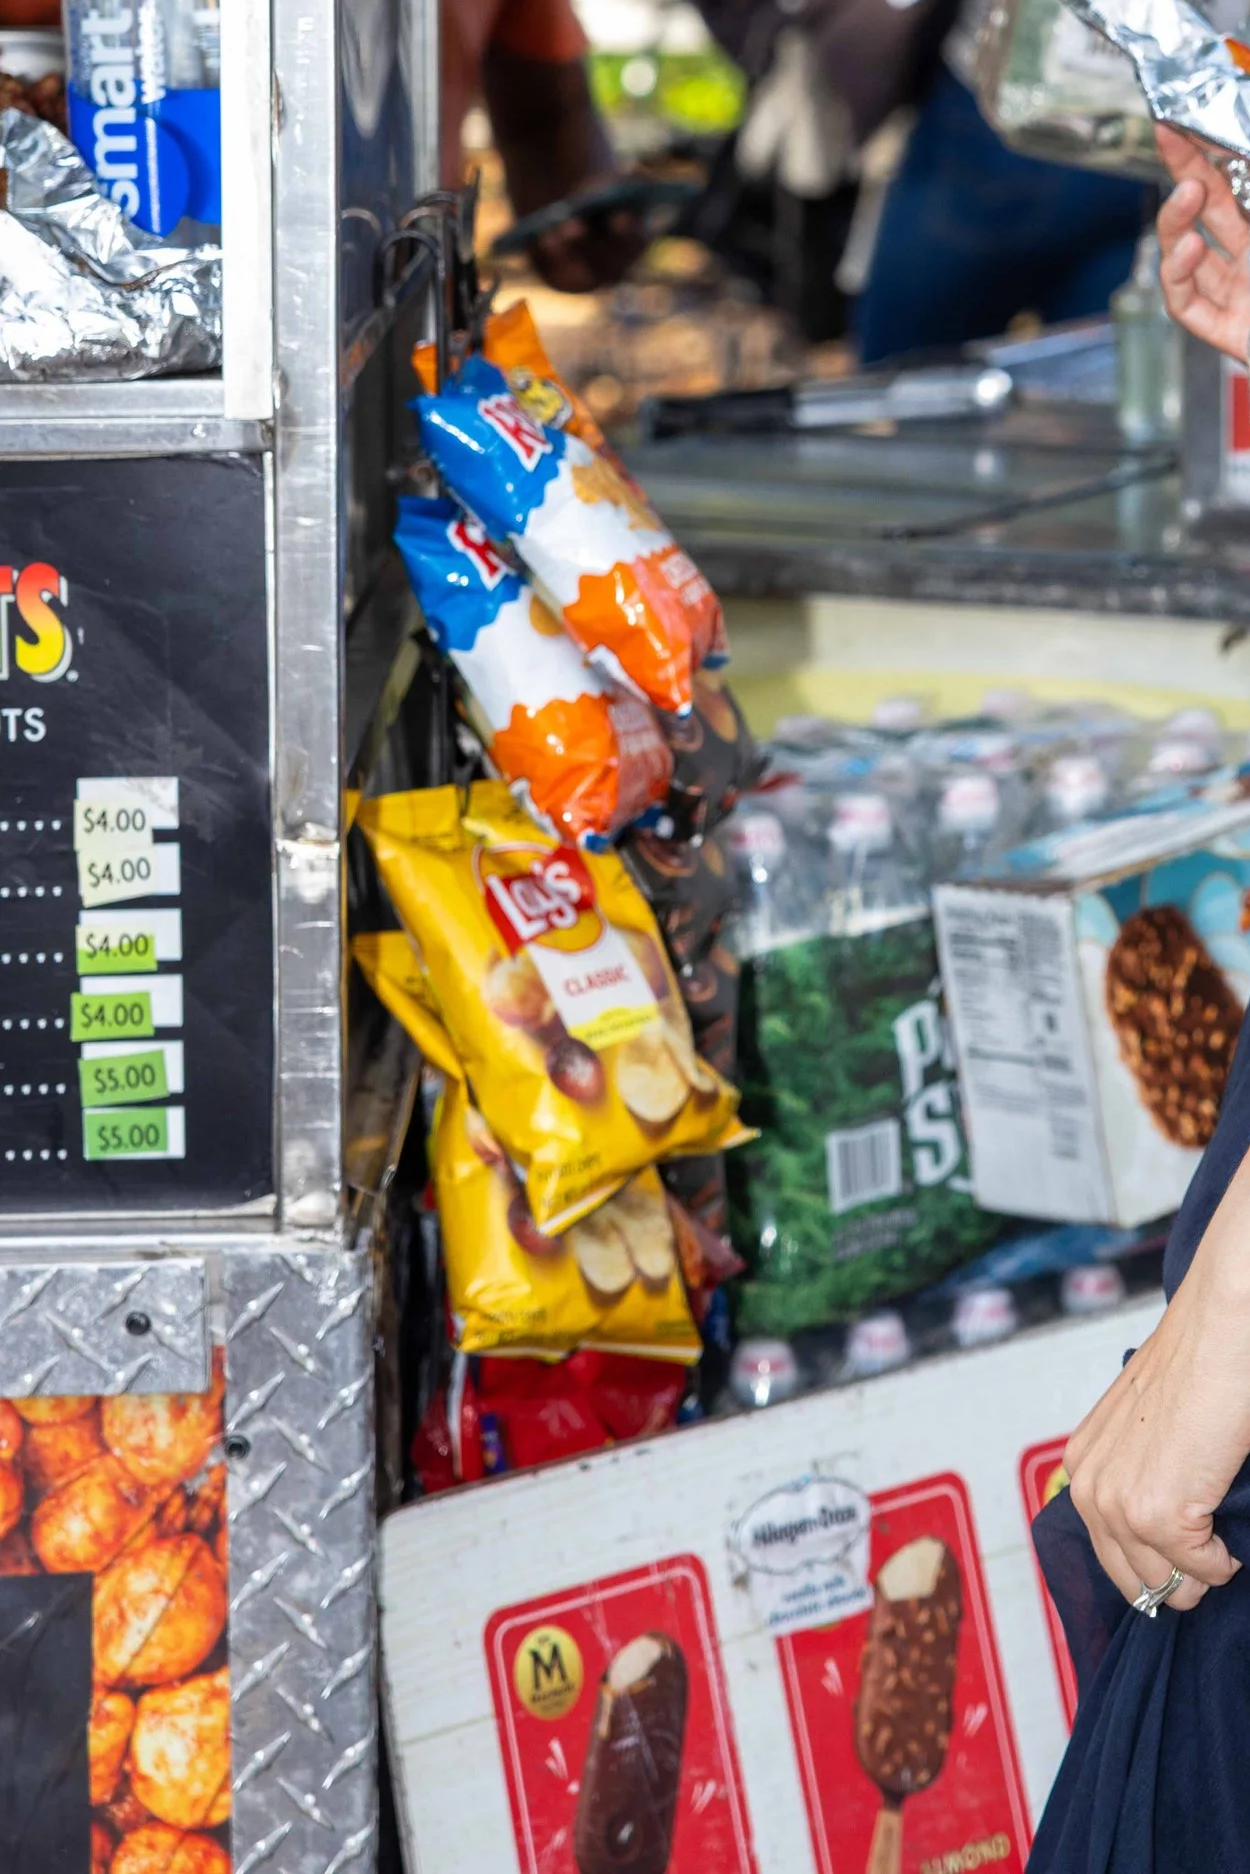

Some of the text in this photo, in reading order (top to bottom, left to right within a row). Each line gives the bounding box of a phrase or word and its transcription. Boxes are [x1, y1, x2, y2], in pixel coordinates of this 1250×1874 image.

[82, 8, 141, 220] smart
[84, 808, 147, 834] $4.00
[87, 857, 152, 888] $4.00
[86, 933, 150, 959] $4.00
[80, 1002, 145, 1028] $4.00
[94, 1064, 157, 1093] $5.00
[97, 1123, 161, 1154] $5.00
[529, 1643, 569, 1692] M
